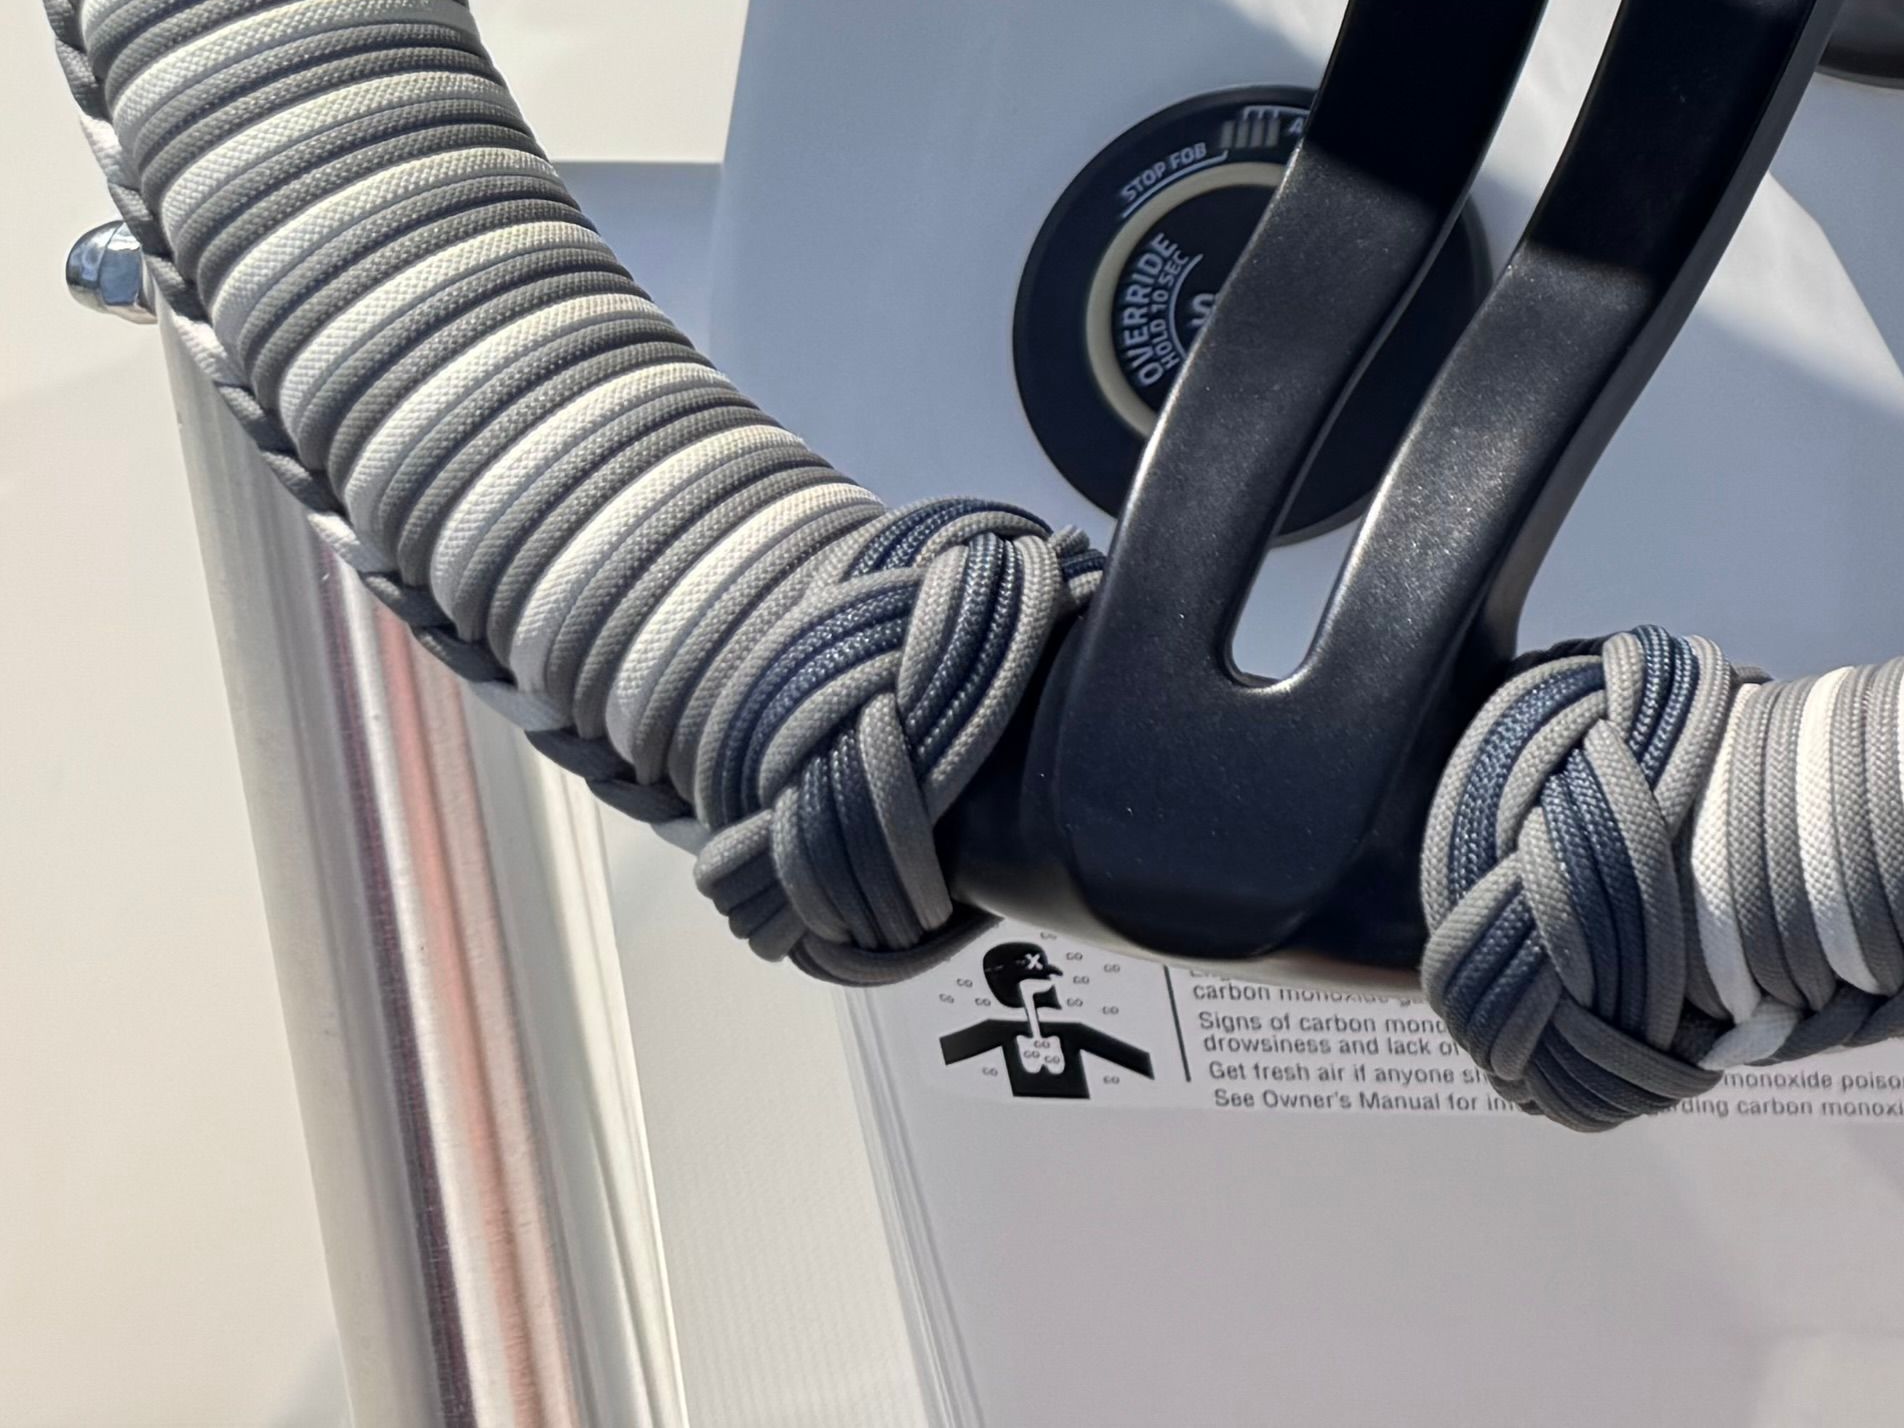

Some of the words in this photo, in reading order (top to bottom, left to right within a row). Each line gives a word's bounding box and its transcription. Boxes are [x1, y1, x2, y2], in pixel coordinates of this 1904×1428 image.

[1120, 161, 1167, 203] STOP
[1169, 142, 1208, 171] FOB
[1158, 249, 1190, 287] SEC
[1122, 232, 1178, 386] OVERRIDE
[1149, 318, 1181, 370] HOLD
[1193, 981, 1272, 1002] carbon
[1198, 1011, 1263, 1034] Signs
[1270, 1013, 1291, 1032] of
[1299, 1013, 1378, 1033] carbon
[1203, 1034, 1332, 1056] drowsiness
[1338, 1036, 1380, 1056] and
[1386, 1037, 1432, 1057] lack
[1208, 1060, 1247, 1082] Get
[1253, 1062, 1310, 1084] fresh
[1319, 1064, 1346, 1083] air
[1353, 1065, 1367, 1084] if
[1374, 1066, 1456, 1087] anyone
[1723, 1068, 1833, 1091] monoxide
[1213, 1088, 1255, 1108] See
[1261, 1088, 1352, 1110] Owner's
[1358, 1089, 1441, 1111] Manual
[1446, 1091, 1478, 1111] for
[1735, 1096, 1814, 1118] carbon
